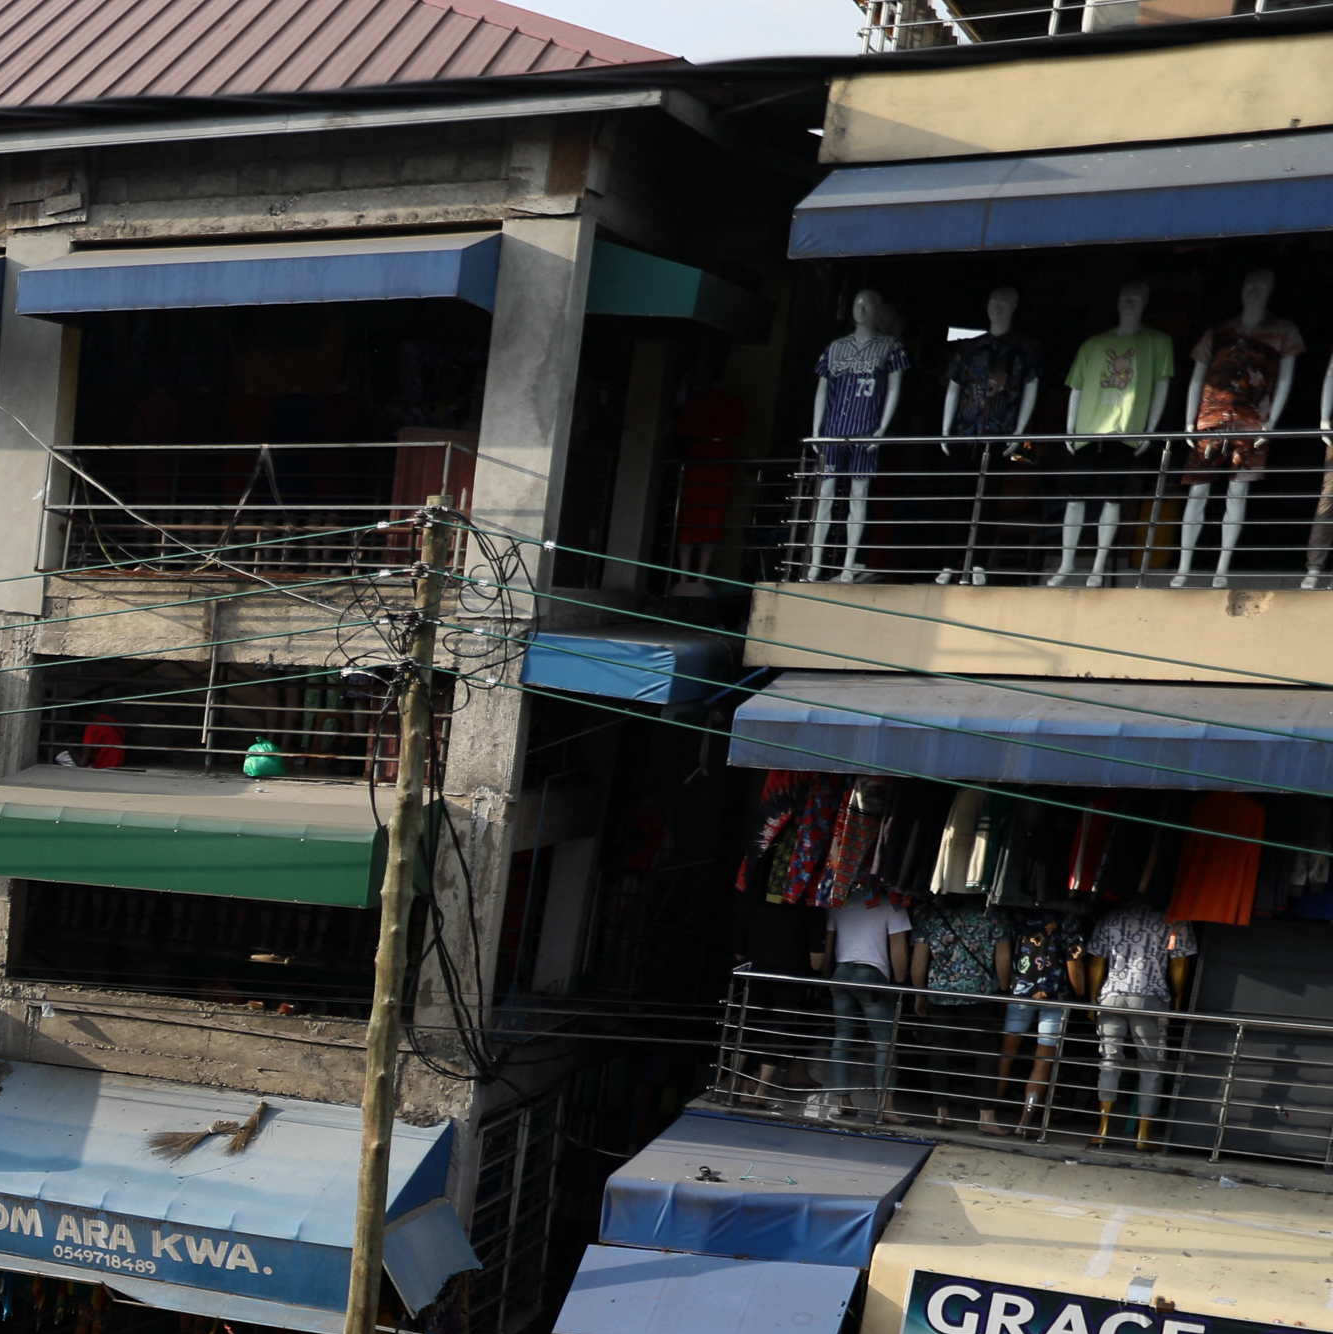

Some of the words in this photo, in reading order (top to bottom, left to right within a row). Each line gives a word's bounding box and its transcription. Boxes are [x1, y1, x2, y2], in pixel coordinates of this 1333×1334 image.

[53, 1245, 156, 1274] 0549718489
[55, 1214, 136, 1254] ARA
[151, 1229, 272, 1275] KWA.
